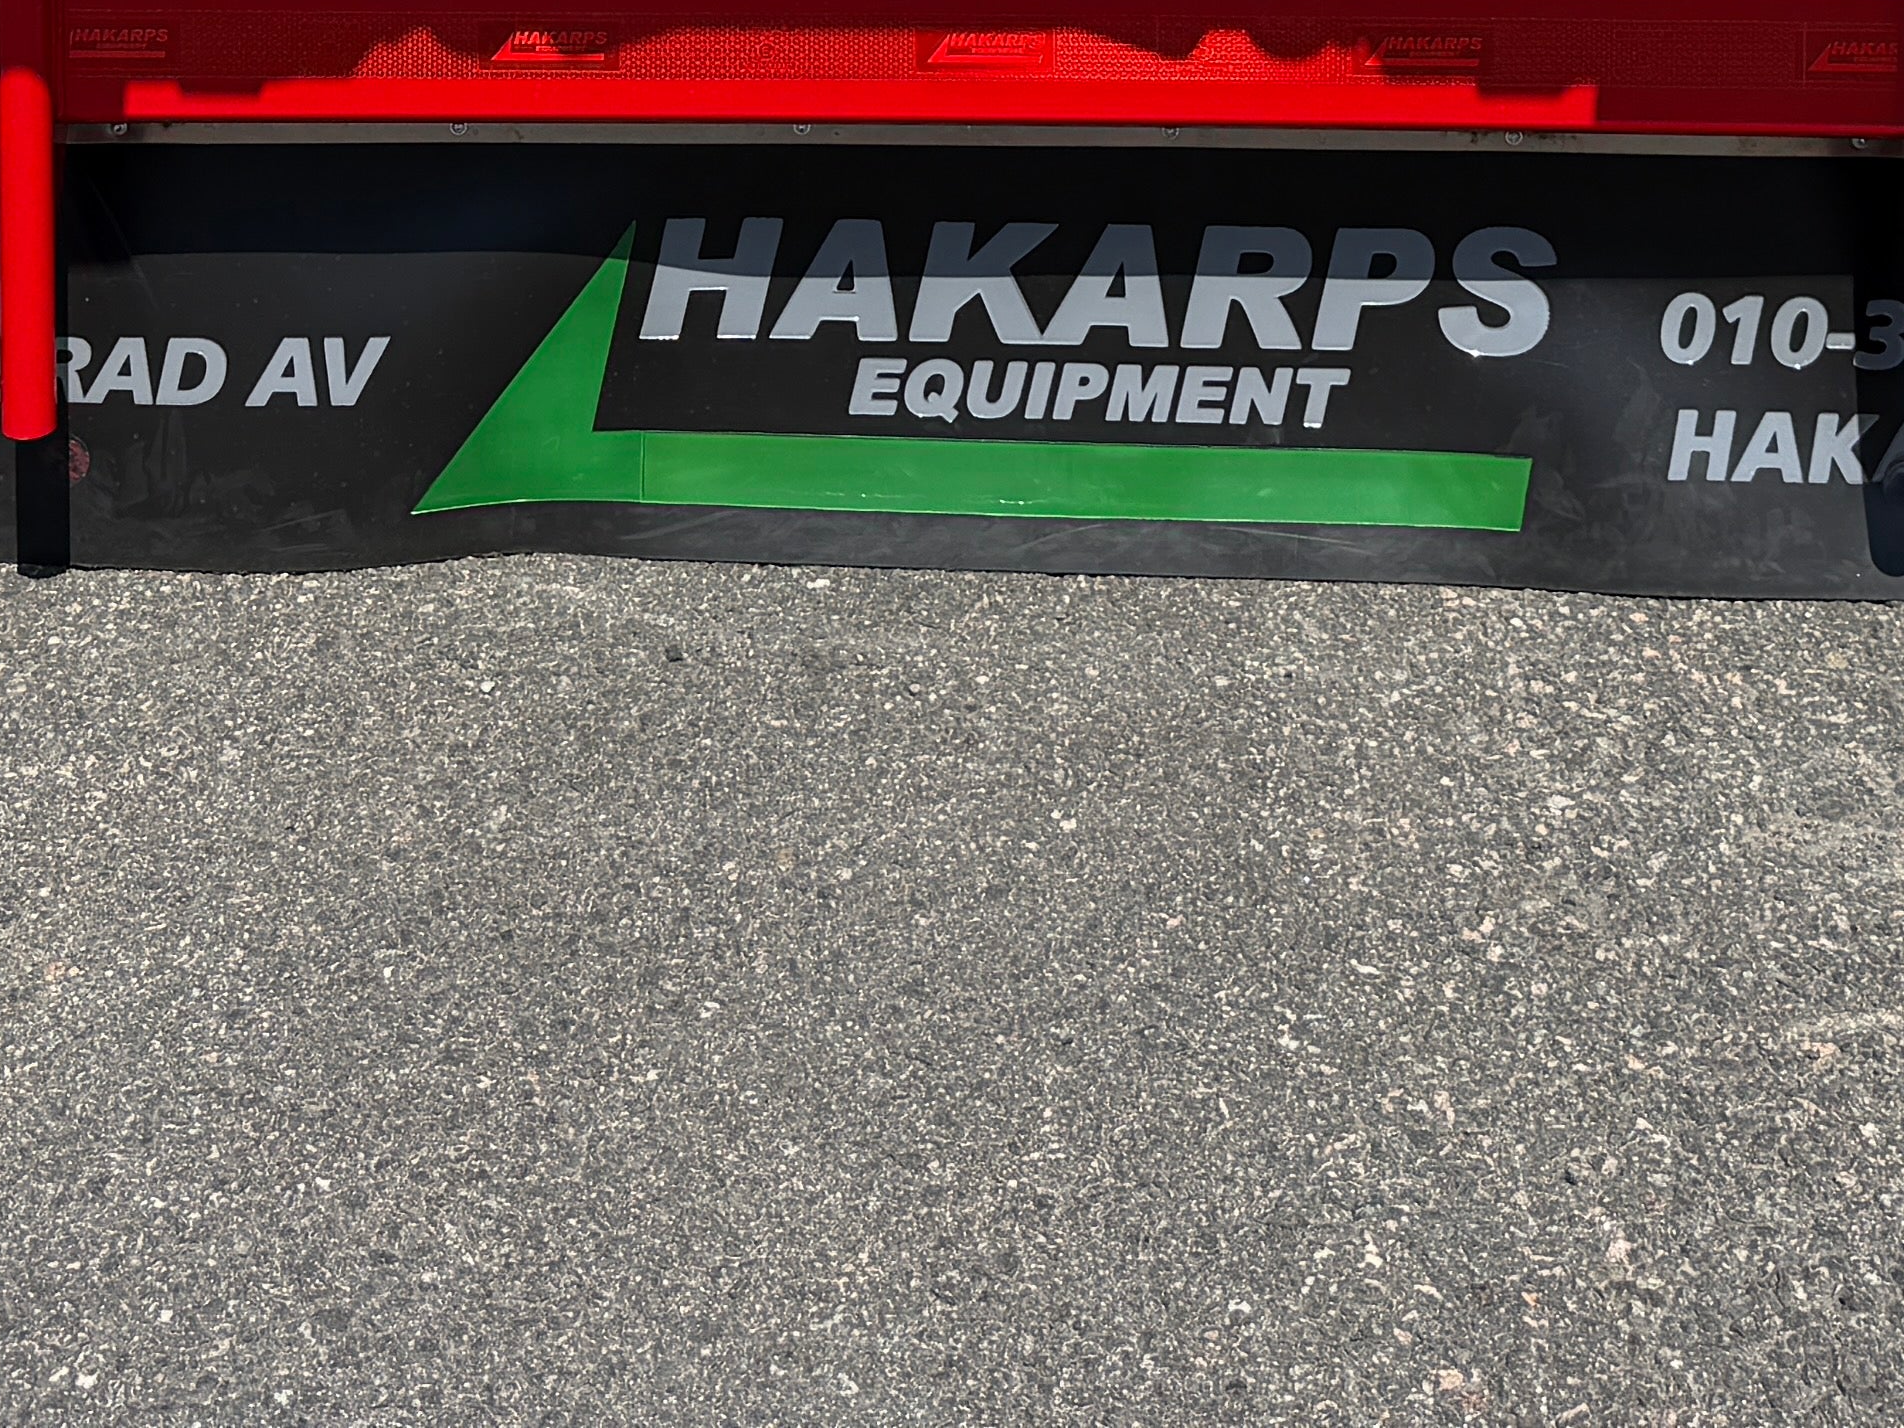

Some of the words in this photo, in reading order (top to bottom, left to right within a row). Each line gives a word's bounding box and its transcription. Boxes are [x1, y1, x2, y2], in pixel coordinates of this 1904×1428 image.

[73, 28, 169, 43] HAKARPS
[512, 30, 608, 45] HAKARPS
[1388, 36, 1483, 50] HAKARPS
[639, 216, 1559, 356] HAKARPS
[244, 336, 391, 407] AV
[848, 356, 1351, 428] EQUIPMENT
